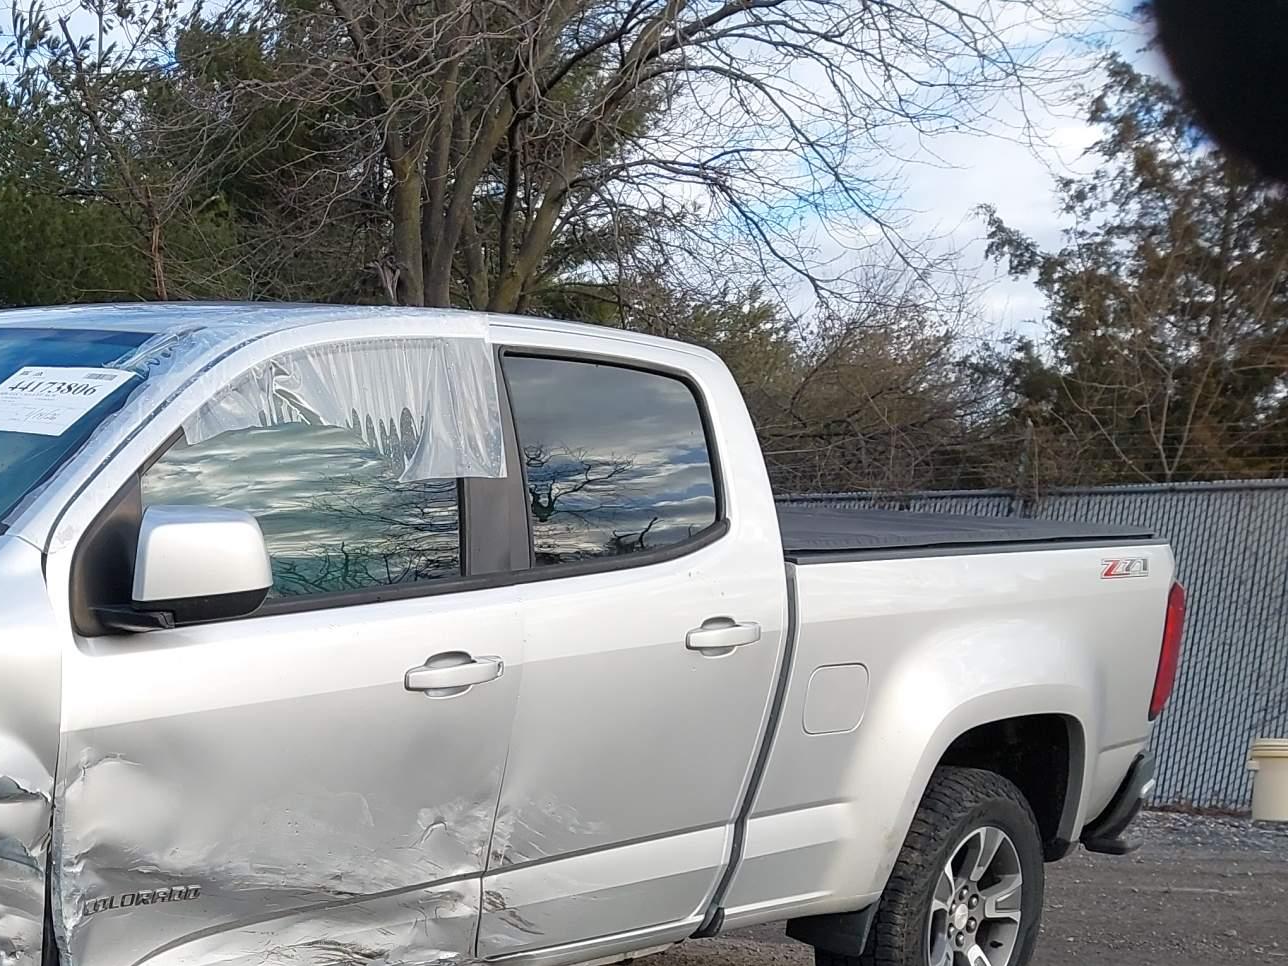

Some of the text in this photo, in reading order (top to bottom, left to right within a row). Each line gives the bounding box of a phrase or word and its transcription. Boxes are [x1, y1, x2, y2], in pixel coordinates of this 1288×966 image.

[8, 380, 102, 396] 44173806
[1100, 558, 1149, 579] Z71
[83, 884, 201, 917] COLORADO
